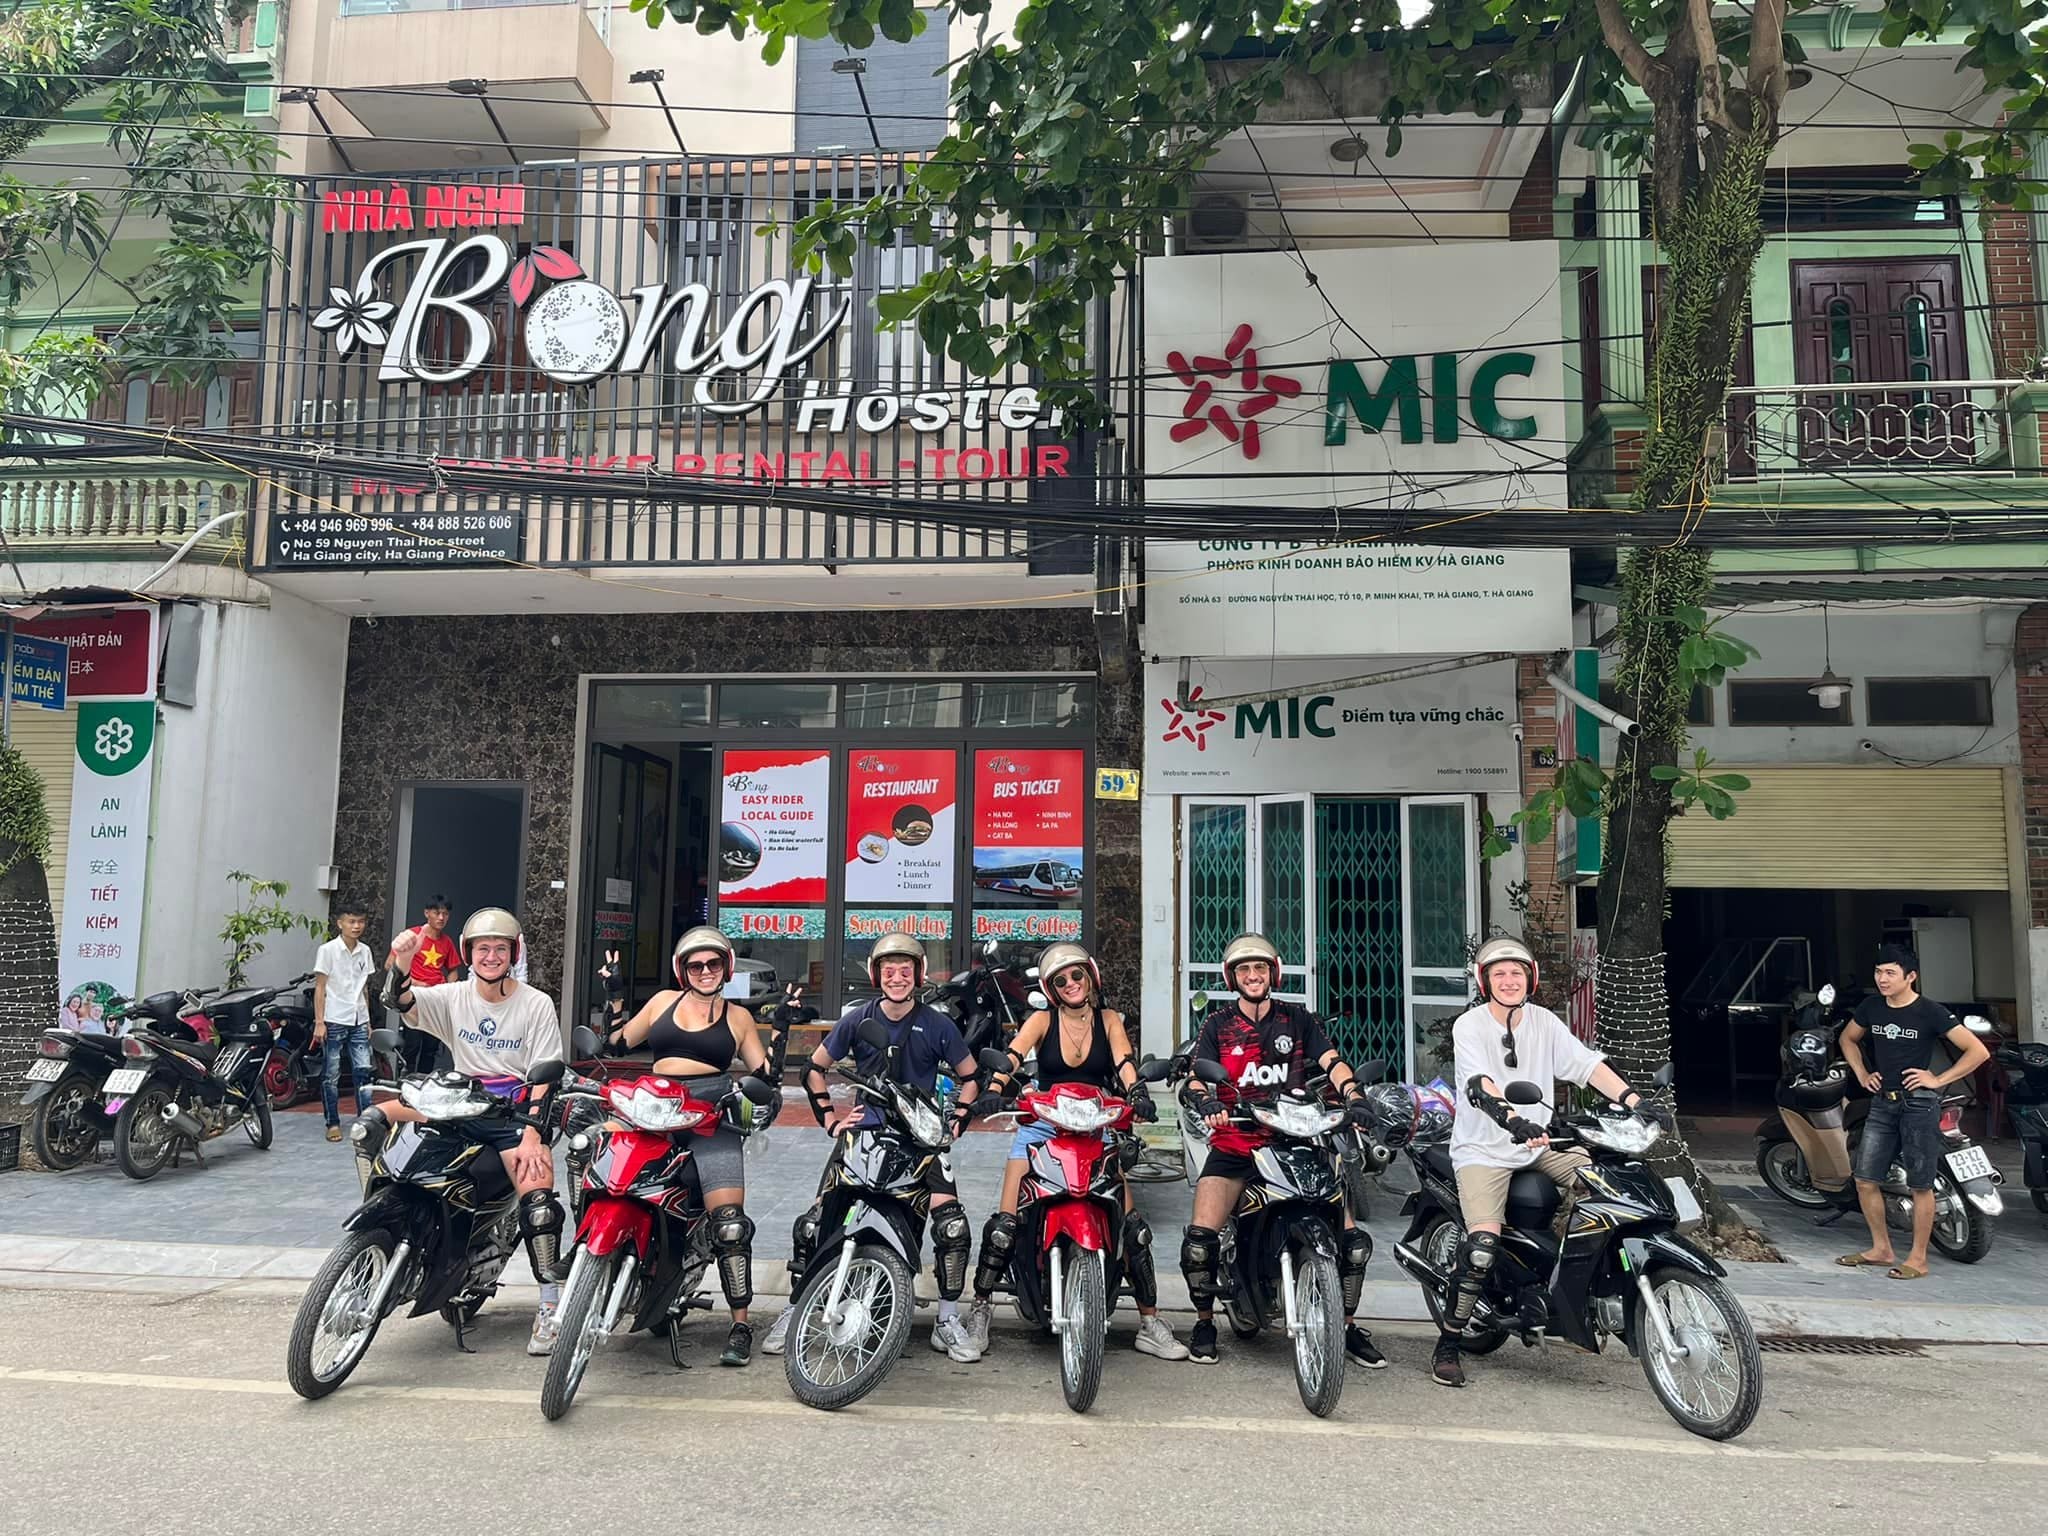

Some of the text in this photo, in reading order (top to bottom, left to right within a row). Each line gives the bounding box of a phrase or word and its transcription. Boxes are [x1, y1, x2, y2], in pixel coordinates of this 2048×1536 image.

[323, 182, 414, 233] NHÀ
[1324, 351, 1538, 446] MIC
[924, 445, 1070, 484] TOUR
[294, 519, 316, 532] +84
[320, 519, 342, 532] 946
[345, 518, 368, 531] 969
[371, 518, 393, 531] 996
[411, 516, 435, 530] +84
[437, 516, 460, 530] 888
[463, 516, 486, 529] 526
[489, 515, 512, 529] 606
[294, 537, 312, 548] No
[315, 537, 331, 548] 59
[334, 536, 383, 551] Nguyen
[447, 535, 485, 547] street
[293, 547, 506, 563] Ha Giang city, Ha Giang Province
[1258, 559, 1291, 570] KINH
[1295, 558, 1342, 569] DOANH
[1416, 556, 1434, 567] KV
[1437, 553, 1457, 566] HÀ
[1461, 555, 1505, 566] GIANG
[1437, 590, 1450, 599] HÀ
[1451, 591, 1481, 600] GIANG,
[1492, 589, 1504, 598] HÀ
[1506, 590, 1534, 598] GIANG
[1234, 696, 1336, 739] MIC
[1342, 706, 1384, 723] Điểm
[863, 779, 940, 798] RESTAURANT
[993, 779, 1061, 799] BUS TICKET
[101, 798, 121, 811] AN
[742, 795, 804, 805] EASY RIDER
[741, 811, 815, 821] LOCAL GUIDE
[90, 822, 127, 838] LÀNH
[90, 859, 119, 875] 安全
[903, 859, 941, 868] Breakfast
[903, 870, 930, 878] Lunch
[90, 883, 119, 901] TIẾT
[903, 881, 933, 889] Dinner
[86, 913, 119, 932] KIỆM
[741, 914, 804, 934] TOUR
[849, 914, 947, 939] Serve all day
[976, 915, 1013, 935] Beer
[1025, 915, 1079, 936] Coffee
[486, 1037, 522, 1050] grand
